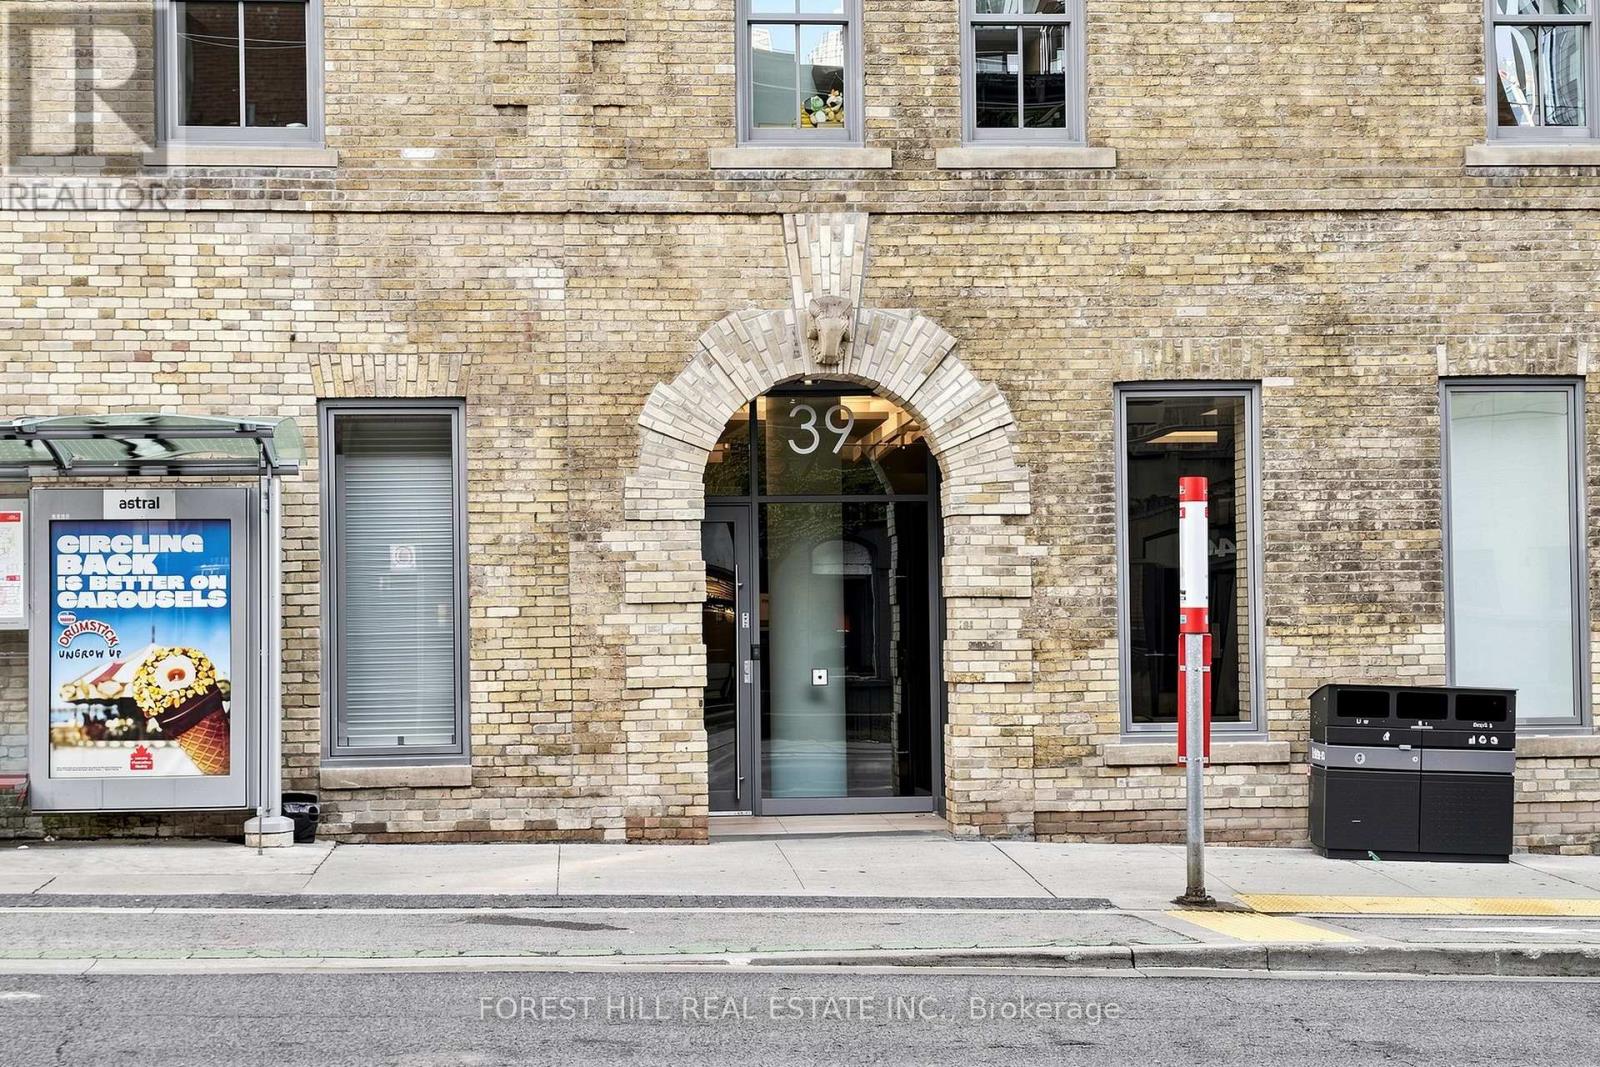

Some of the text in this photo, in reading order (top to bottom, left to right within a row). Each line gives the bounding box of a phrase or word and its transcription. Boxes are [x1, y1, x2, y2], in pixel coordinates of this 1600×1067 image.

[788, 404, 855, 453] 39
[118, 496, 160, 510] astral
[56, 533, 204, 554] CIRCLING
[56, 553, 158, 576] BACK
[56, 574, 227, 591] IS BETTER ON
[56, 590, 228, 609] CAROUSELS
[58, 619, 119, 648] DRUMSTICK
[58, 648, 122, 660] UNGROW UP
